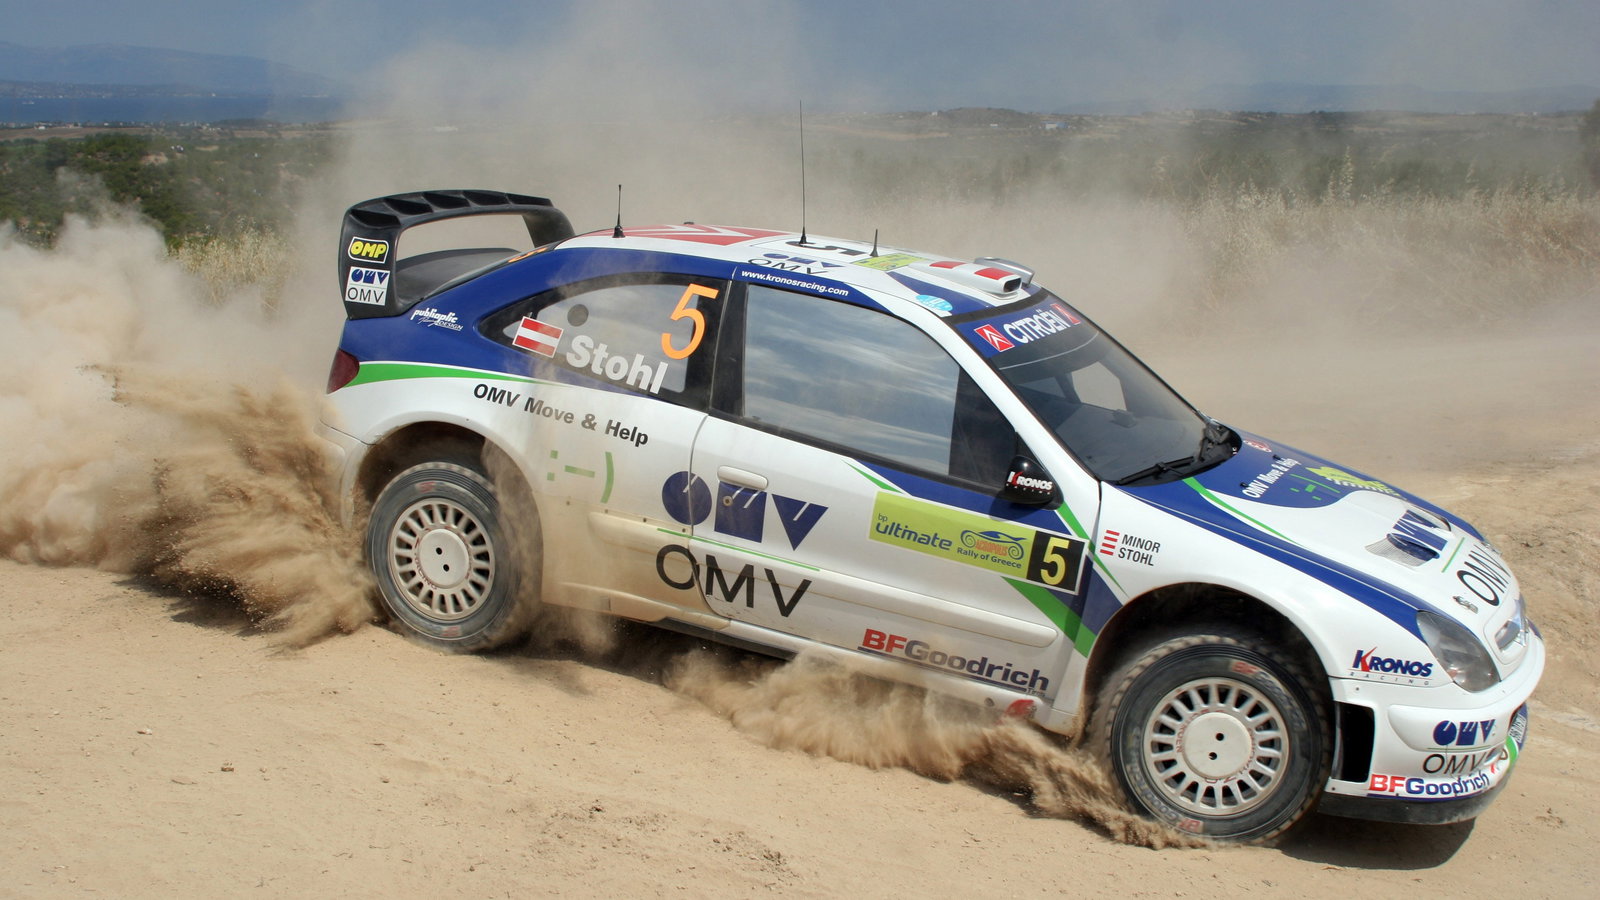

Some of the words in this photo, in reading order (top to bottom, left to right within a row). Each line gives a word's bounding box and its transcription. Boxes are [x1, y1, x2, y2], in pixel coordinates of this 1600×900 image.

[350, 241, 387, 258] OMP
[748, 258, 829, 275] OMV
[347, 287, 385, 303] OMV
[740, 269, 849, 297] www.kronosracing.com
[661, 283, 719, 360] 5
[1003, 309, 1071, 344] CITROËN
[566, 335, 668, 395] Stohl
[473, 383, 521, 408] OMV
[524, 396, 575, 424] Move
[581, 413, 598, 431] &
[605, 419, 649, 447] Help
[1007, 471, 1053, 490] KRONOS
[878, 513, 888, 523] bp
[875, 521, 953, 551] ultimate
[1121, 534, 1161, 553] MINOR
[957, 547, 978, 560] Rally
[980, 553, 990, 561] of
[990, 555, 1022, 569] Greece
[1040, 537, 1070, 585] 5
[1118, 547, 1155, 566] STOHL
[656, 544, 812, 618] OMV
[861, 628, 1050, 691] BFGoodrich
[1352, 646, 1434, 677] KRONOS
[1350, 673, 1430, 686] RACING
[1422, 752, 1486, 776] OMV
[1369, 771, 1490, 796] BFGoodrich
